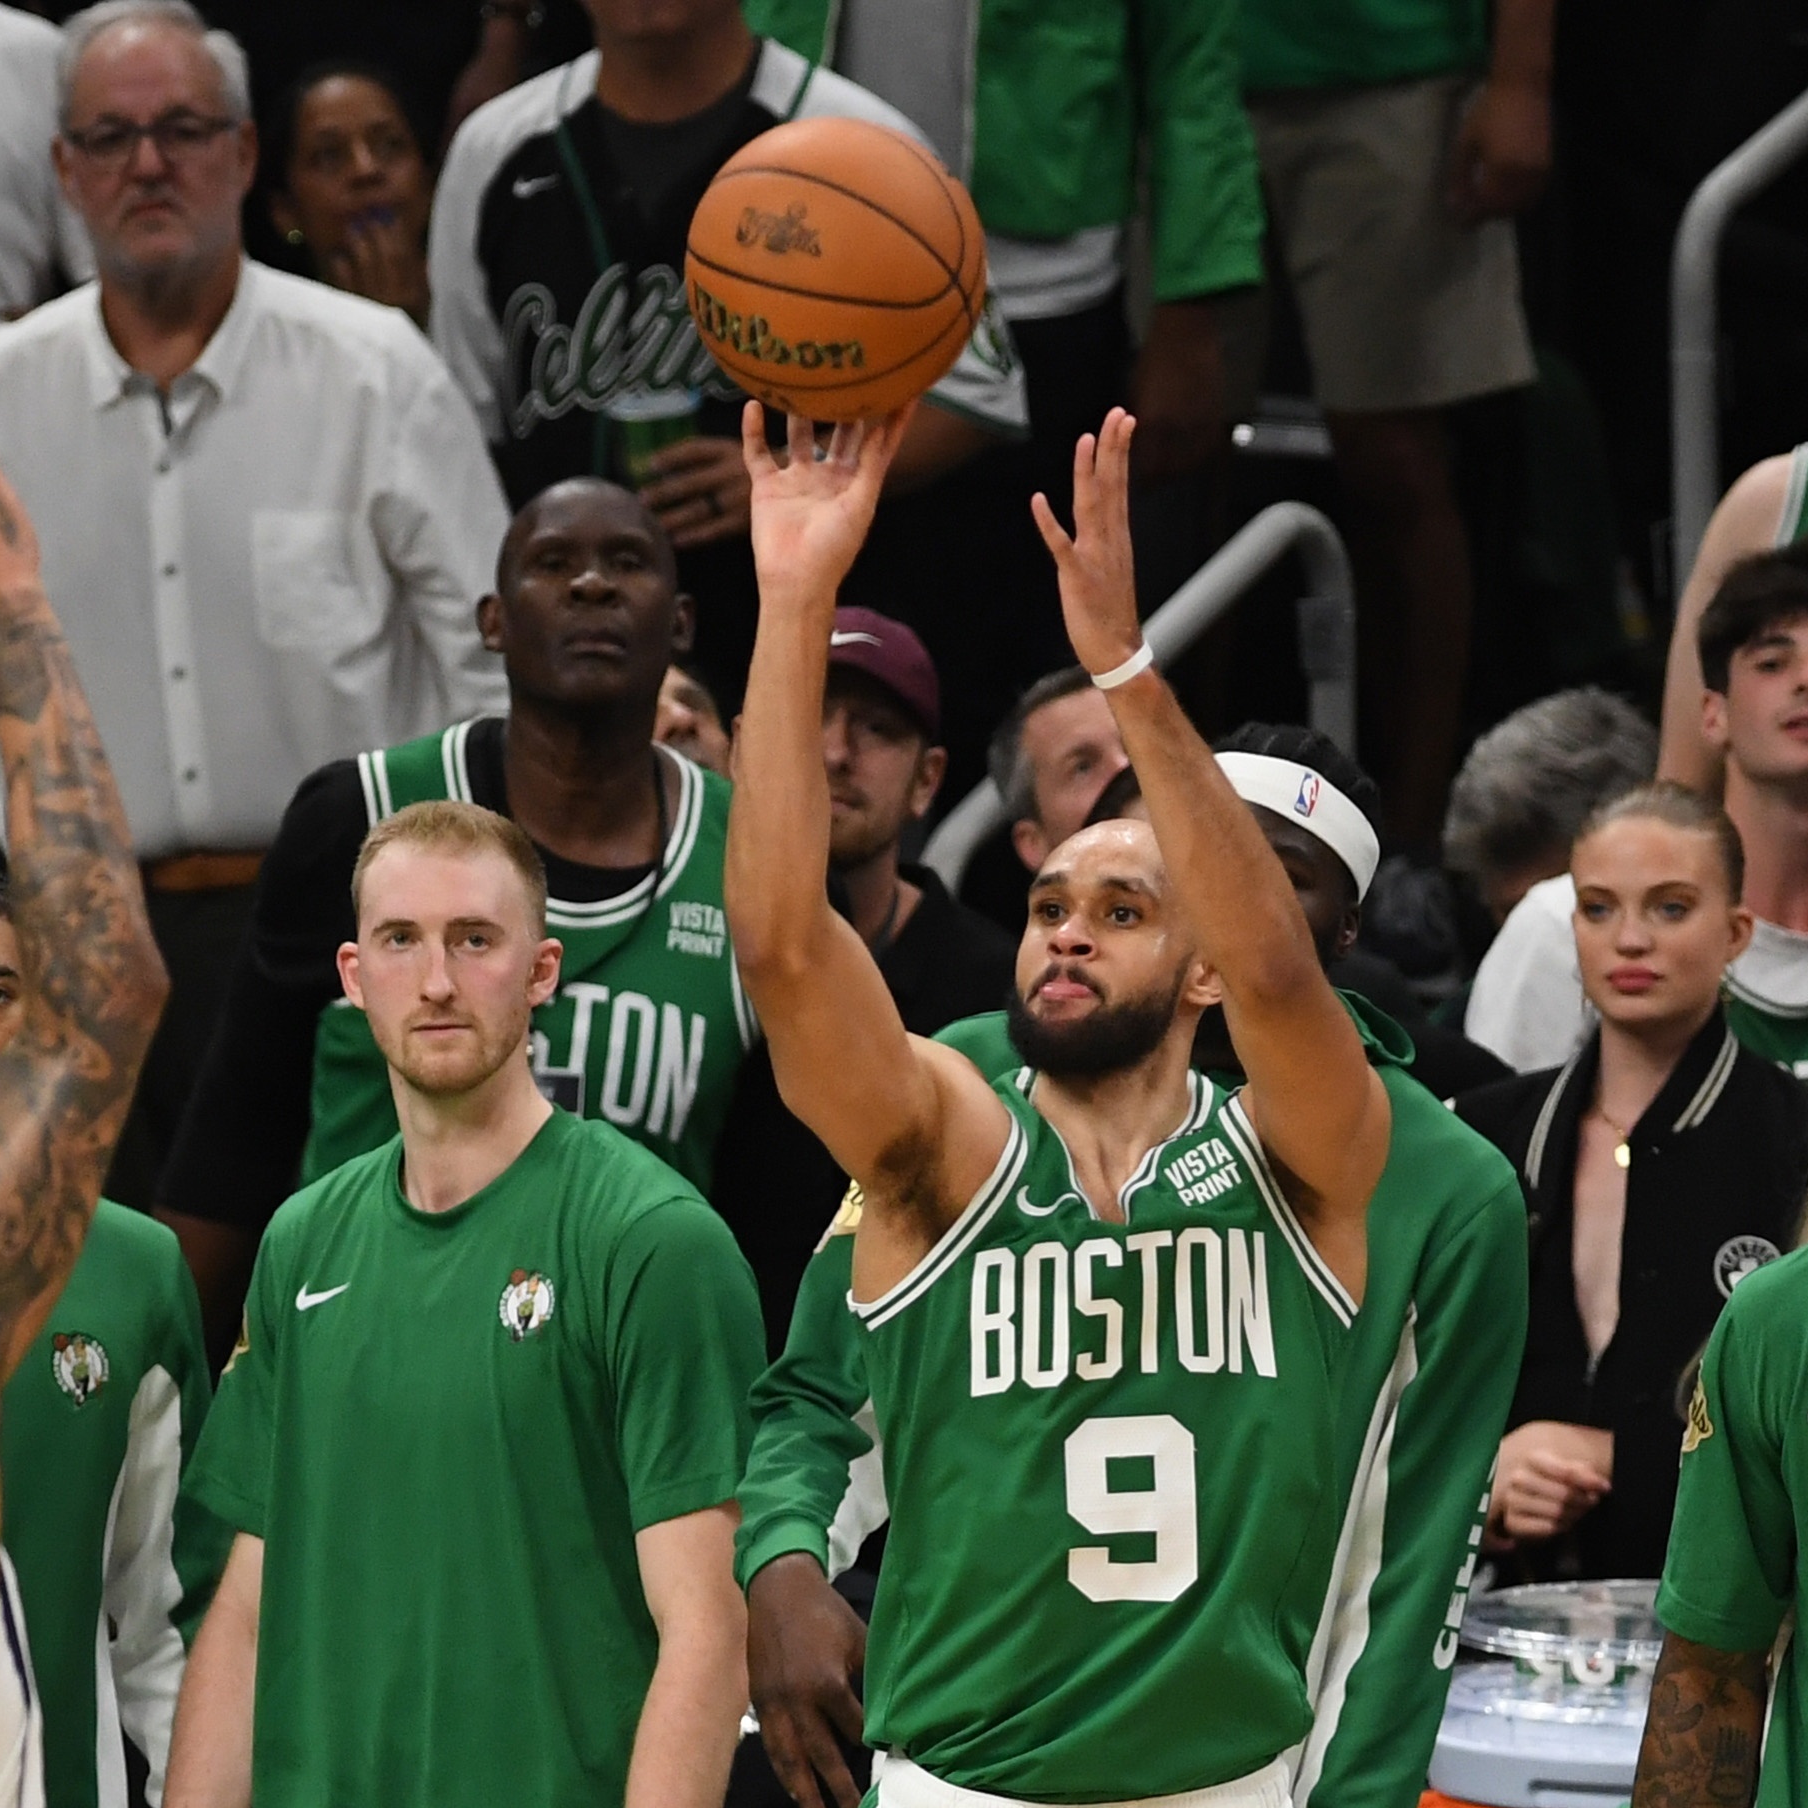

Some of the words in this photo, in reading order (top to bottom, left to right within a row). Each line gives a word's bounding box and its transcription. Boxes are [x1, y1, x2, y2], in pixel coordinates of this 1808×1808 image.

[692, 280, 866, 369] Wilson
[670, 901, 726, 937] VISTA
[1163, 1138, 1235, 1190] VISTA
[1178, 1162, 1243, 1207] PRINT
[970, 1227, 1277, 1398] BOSTON
[1064, 1414, 1198, 1603] 9
